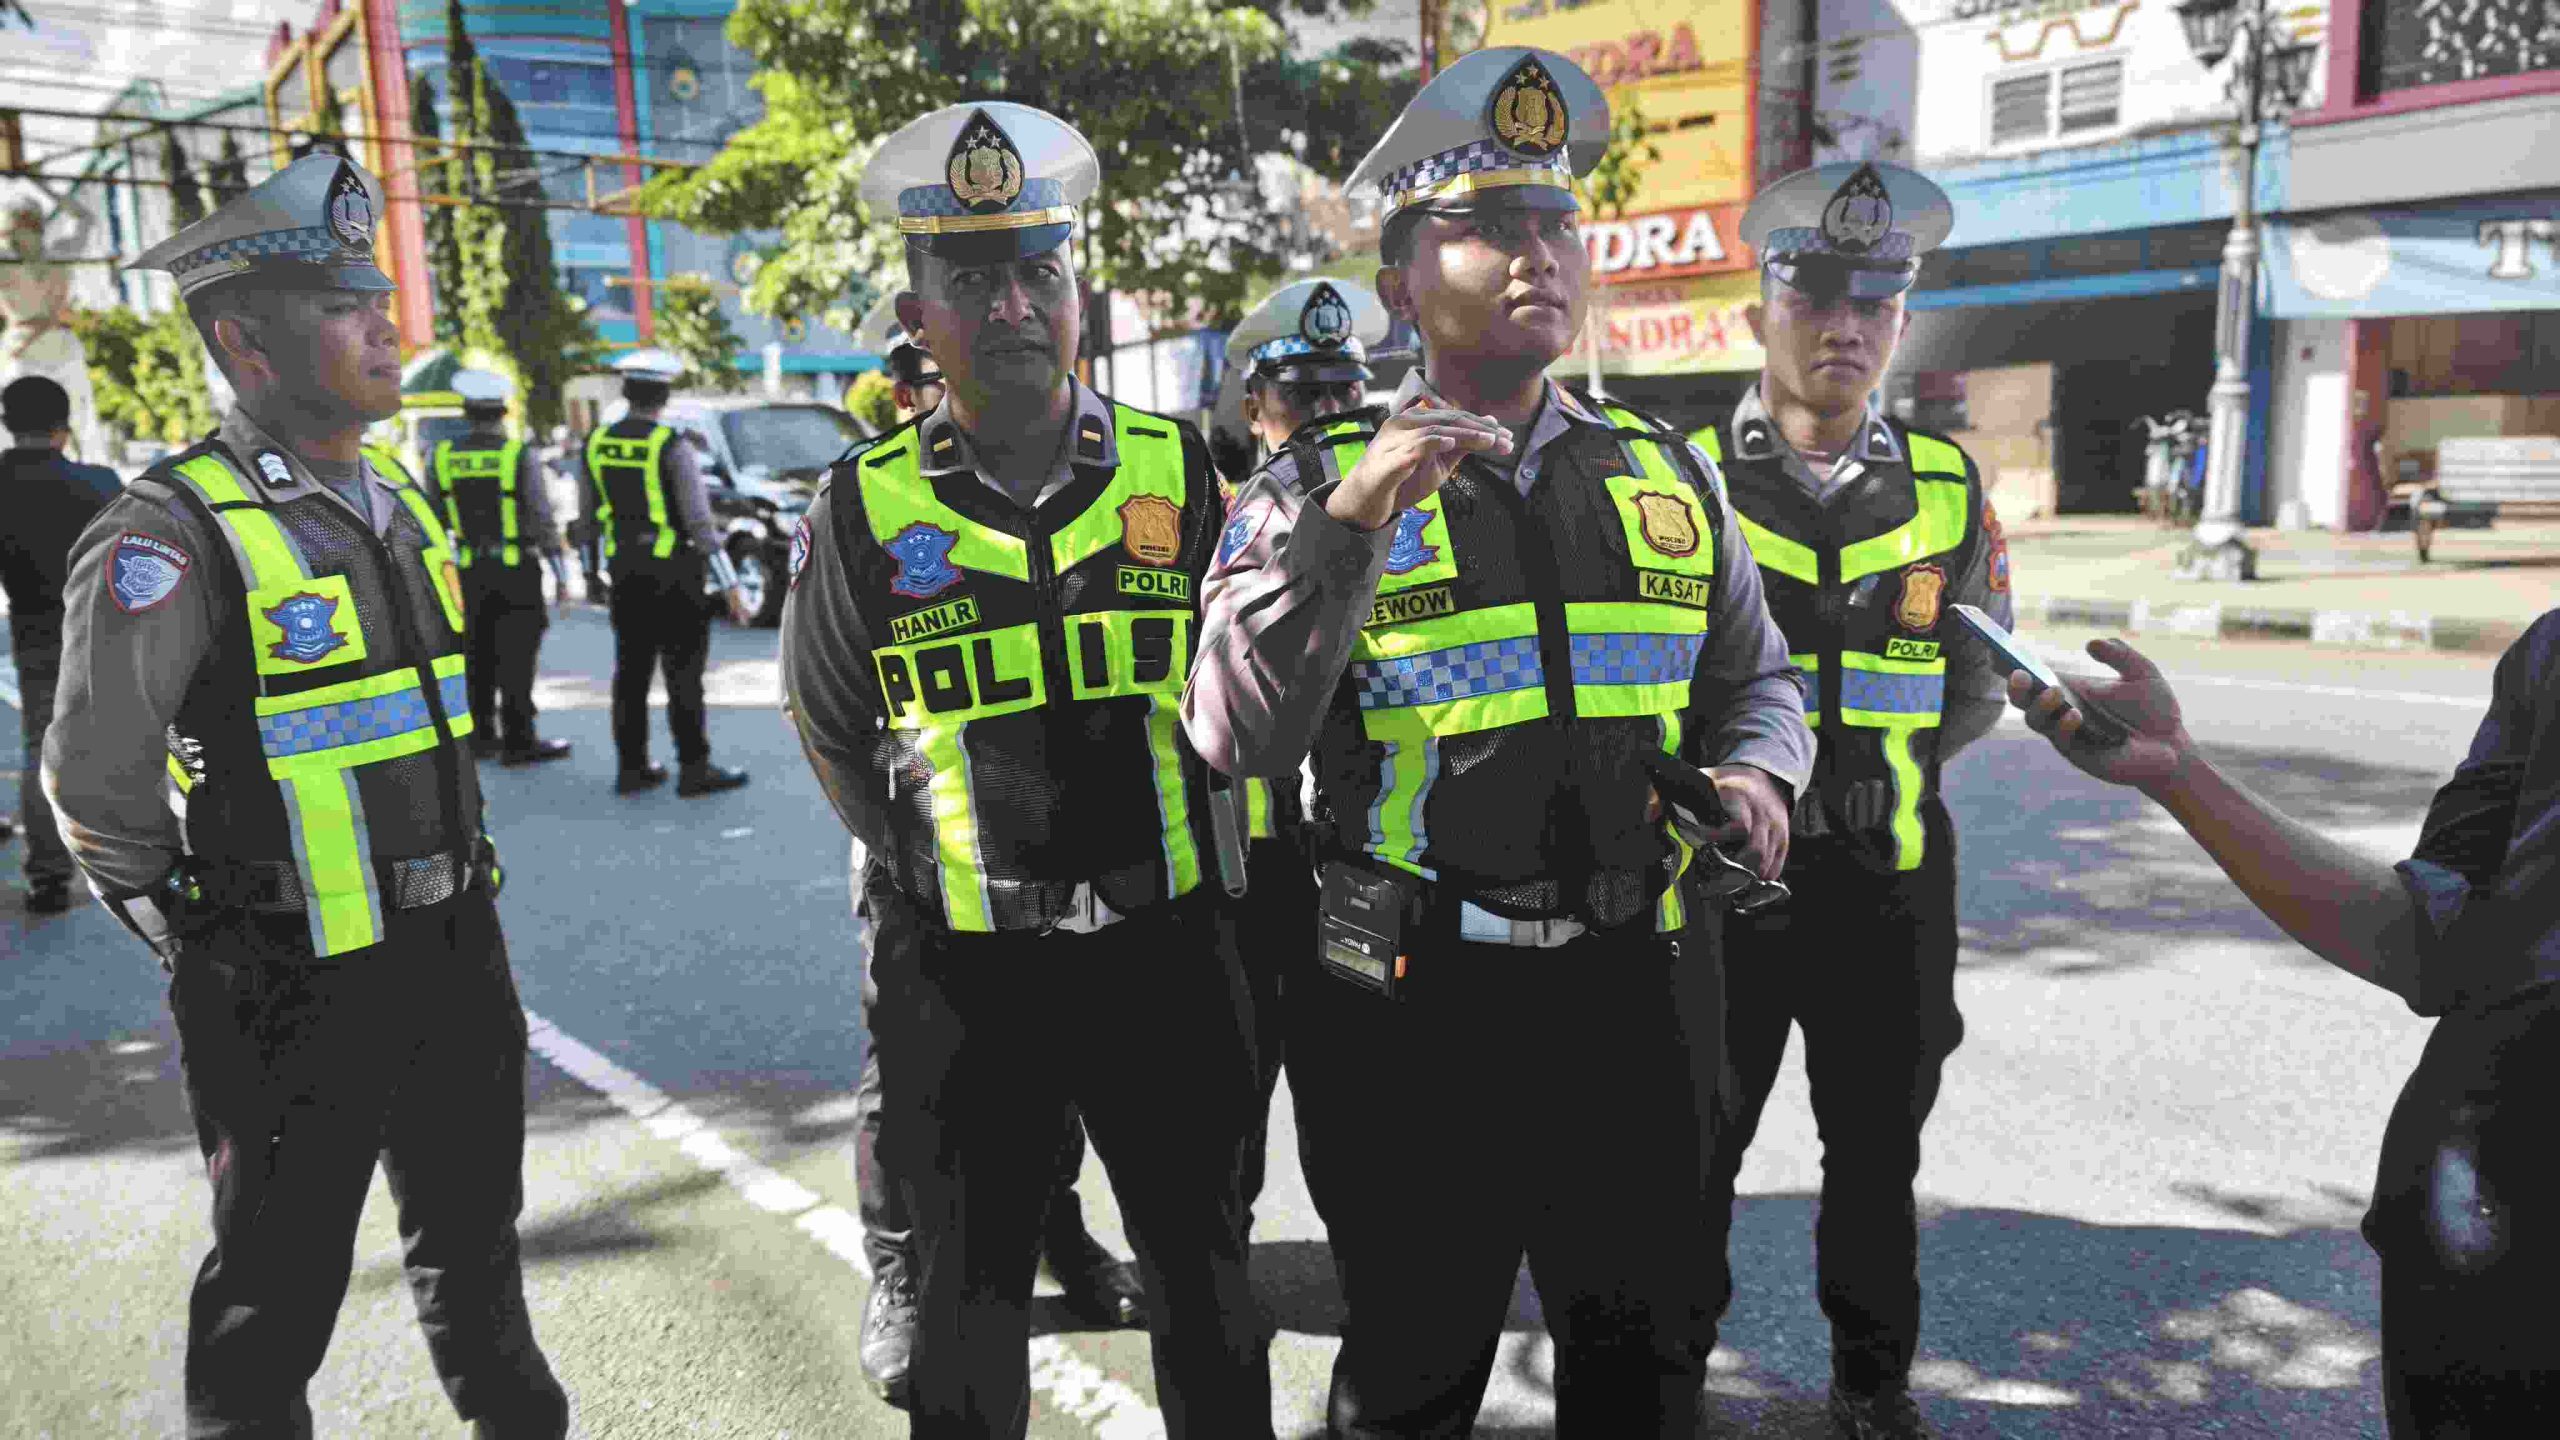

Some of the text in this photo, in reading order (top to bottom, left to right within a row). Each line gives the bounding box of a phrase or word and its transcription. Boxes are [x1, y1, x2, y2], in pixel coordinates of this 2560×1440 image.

[1120, 572, 1188, 596] POLRI
[1645, 574, 1704, 602] KASAT
[893, 601, 971, 641] HANI.R
[1889, 641, 1936, 656] POLRI
